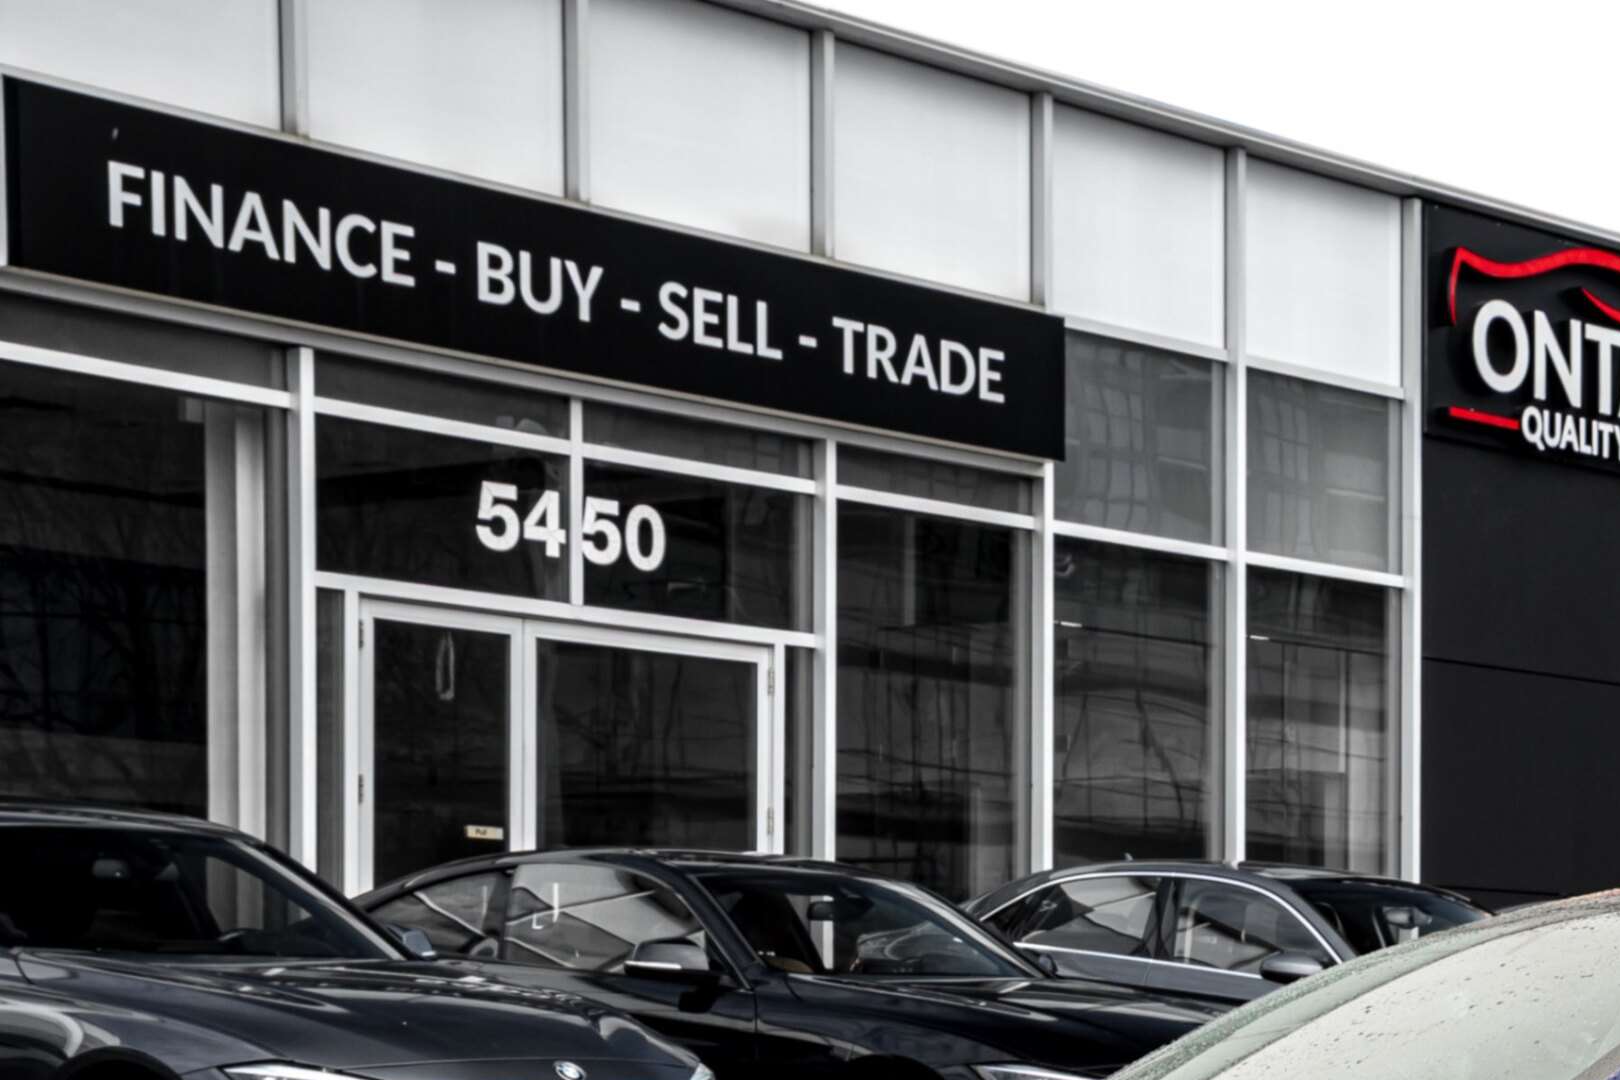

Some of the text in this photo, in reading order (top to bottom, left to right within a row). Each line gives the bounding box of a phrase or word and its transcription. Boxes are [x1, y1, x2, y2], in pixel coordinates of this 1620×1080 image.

[107, 160, 416, 288] FINANCE
[476, 241, 604, 322] BUY
[657, 281, 784, 361] SELL
[831, 316, 1006, 404] TRADE
[475, 481, 667, 571] 5450
